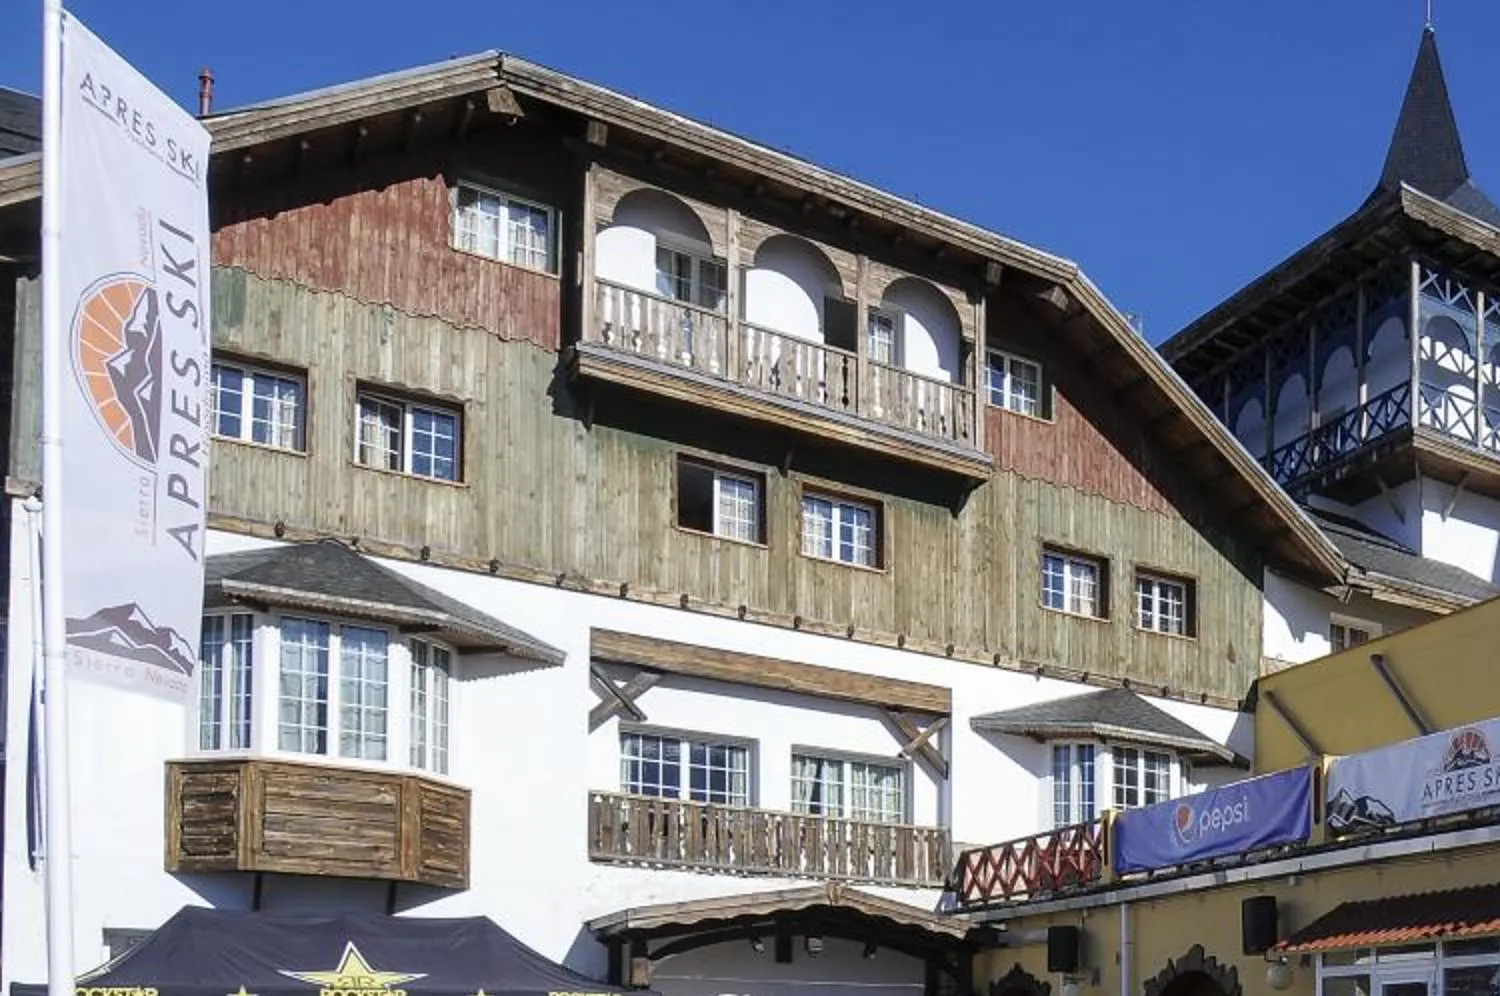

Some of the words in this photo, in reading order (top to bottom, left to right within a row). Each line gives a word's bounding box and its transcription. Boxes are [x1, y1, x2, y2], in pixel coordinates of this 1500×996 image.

[79, 72, 157, 147] APRES
[166, 138, 201, 182] SKI
[158, 218, 199, 330] SKI
[166, 349, 202, 562] APRES
[1199, 794, 1250, 838] pepsi
[1423, 771, 1477, 801] APRES
